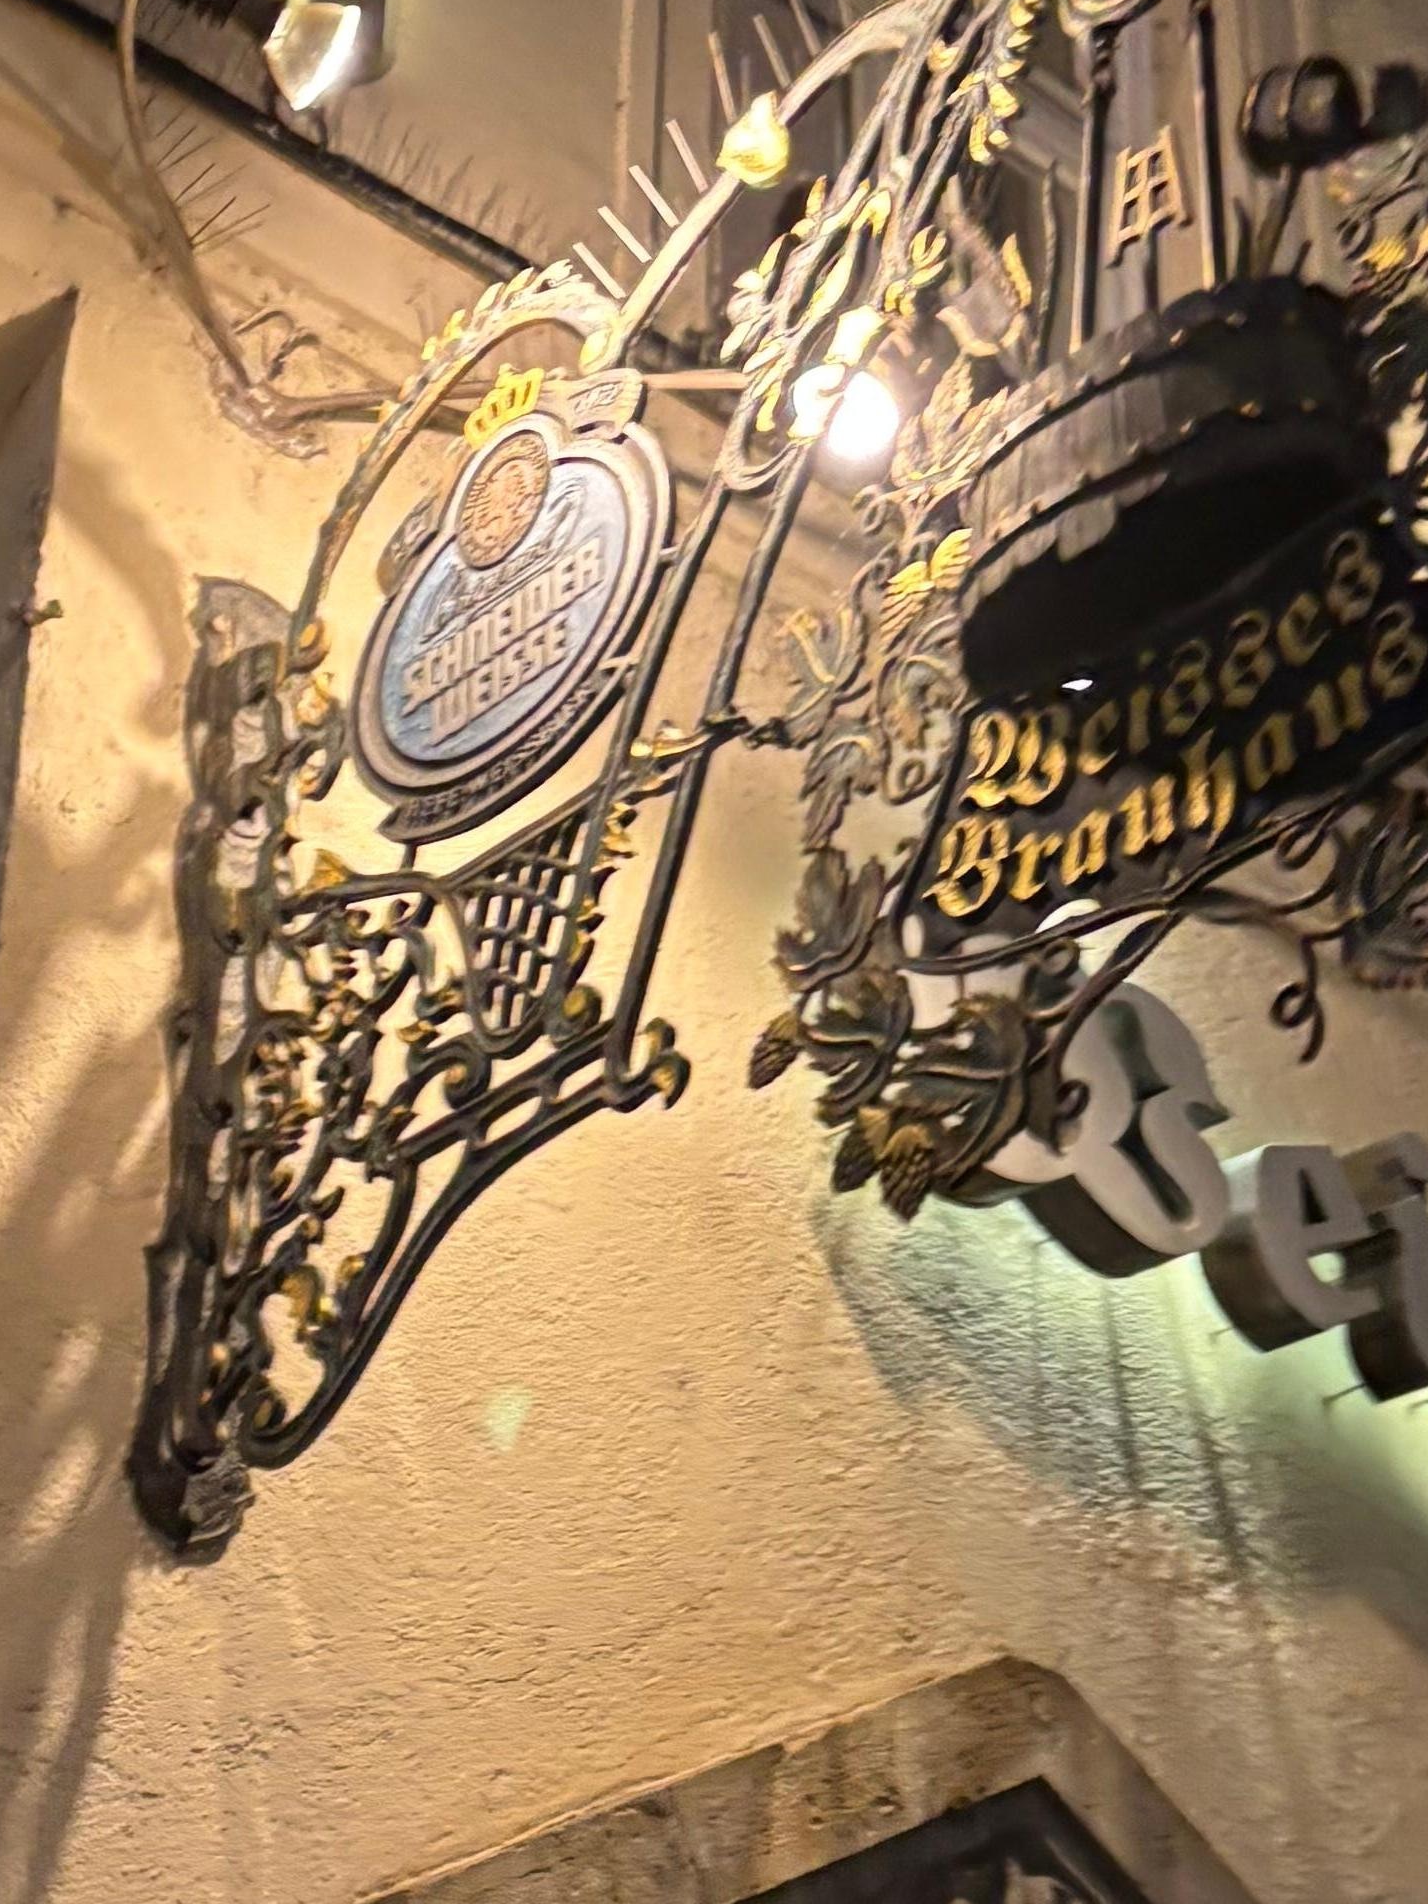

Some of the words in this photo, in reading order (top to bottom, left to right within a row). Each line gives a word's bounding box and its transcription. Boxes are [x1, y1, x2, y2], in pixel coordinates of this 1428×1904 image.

[402, 536, 603, 718] SCHNEIDER
[429, 613, 571, 747] WEISSE
[960, 529, 1383, 809] Weisses
